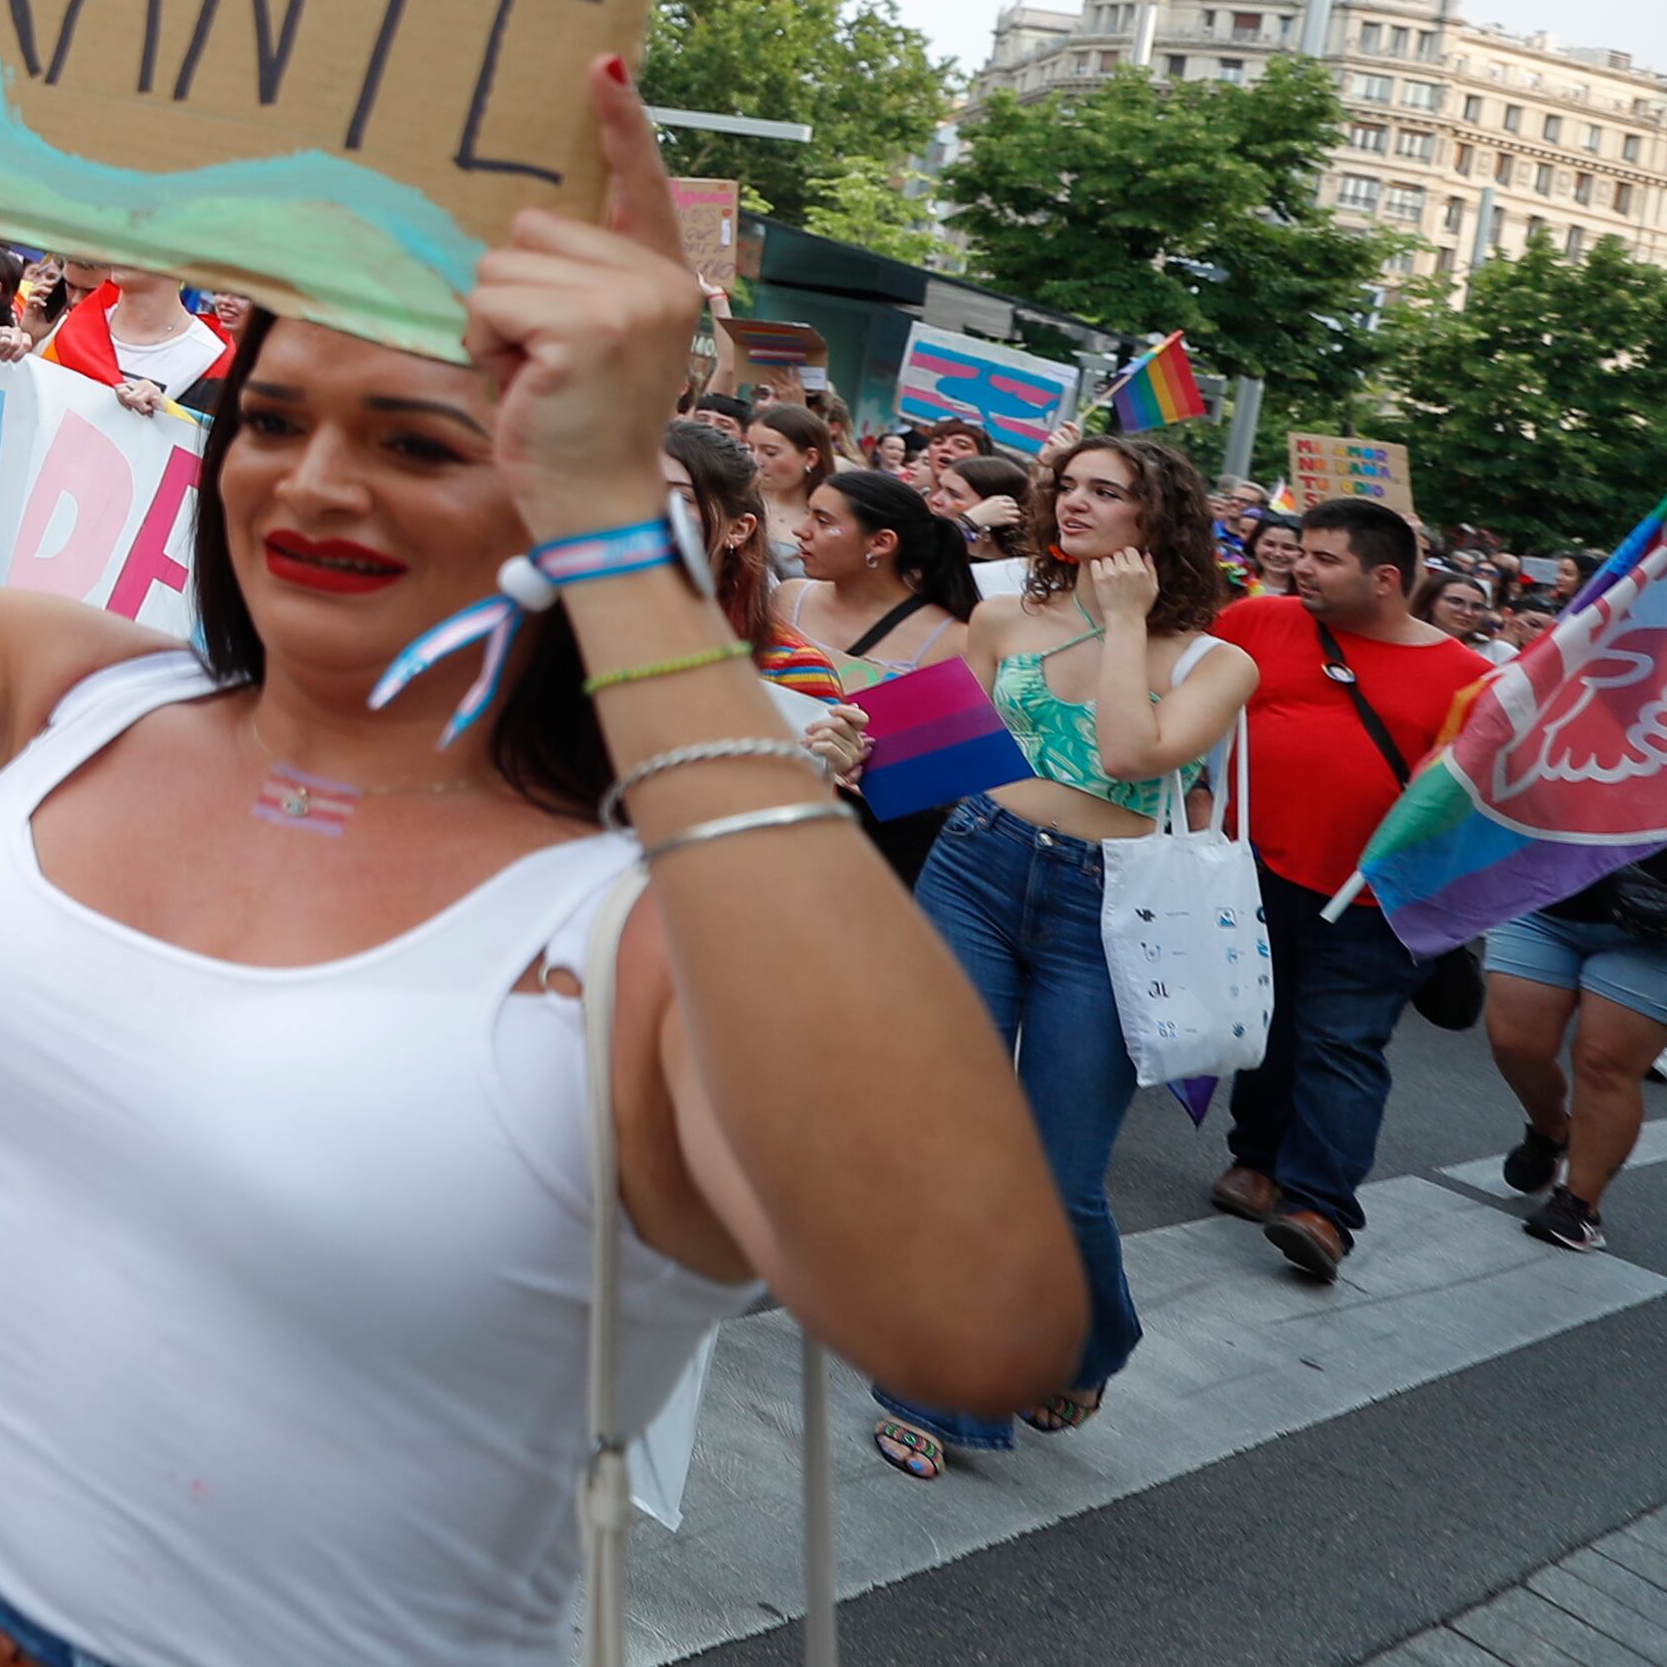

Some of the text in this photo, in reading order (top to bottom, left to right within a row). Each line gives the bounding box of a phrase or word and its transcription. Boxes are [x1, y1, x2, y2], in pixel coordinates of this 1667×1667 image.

[1297, 439, 1387, 462] MI AMOR
[1298, 456, 1326, 471] NO
[1341, 479, 1385, 498] ODIO
